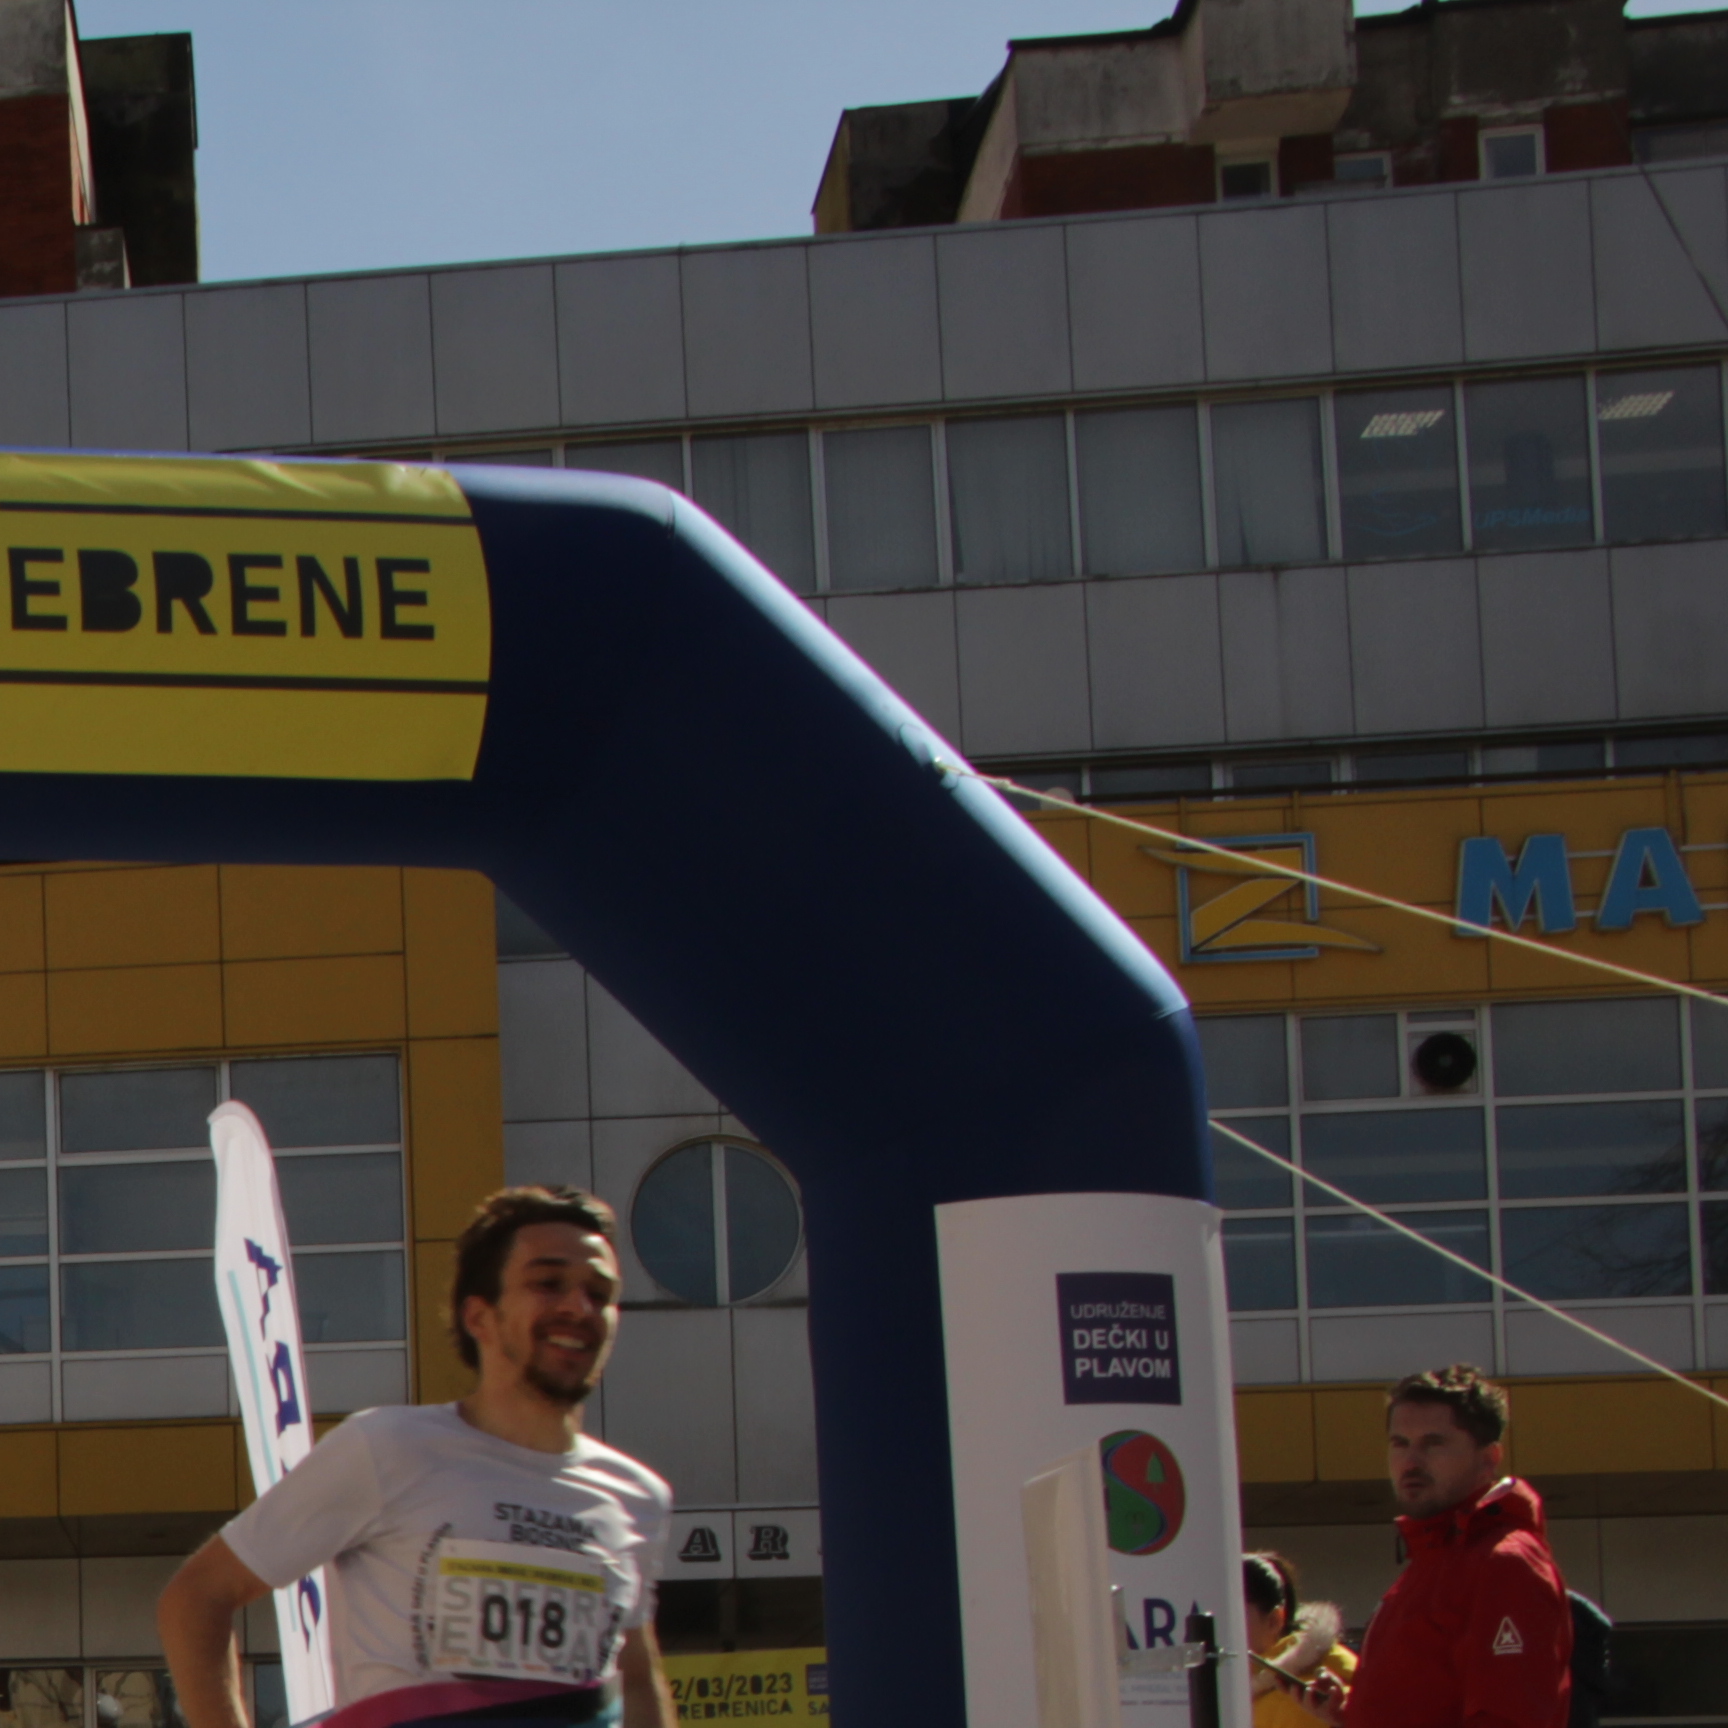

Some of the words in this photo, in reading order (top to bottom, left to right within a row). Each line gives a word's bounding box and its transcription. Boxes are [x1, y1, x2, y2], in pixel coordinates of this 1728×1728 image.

[1070, 1302, 1165, 1319] UDRUŽENJE
[1072, 1323, 1148, 1349] DEČKI
[1155, 1330, 1169, 1350] U
[1075, 1357, 1171, 1378] PLAVOM
[494, 1502, 596, 1538] STAZAMA
[481, 1595, 565, 1648] 018
[671, 1672, 792, 1702] 2/03/2023
[677, 1699, 792, 1720] REBRENICA
